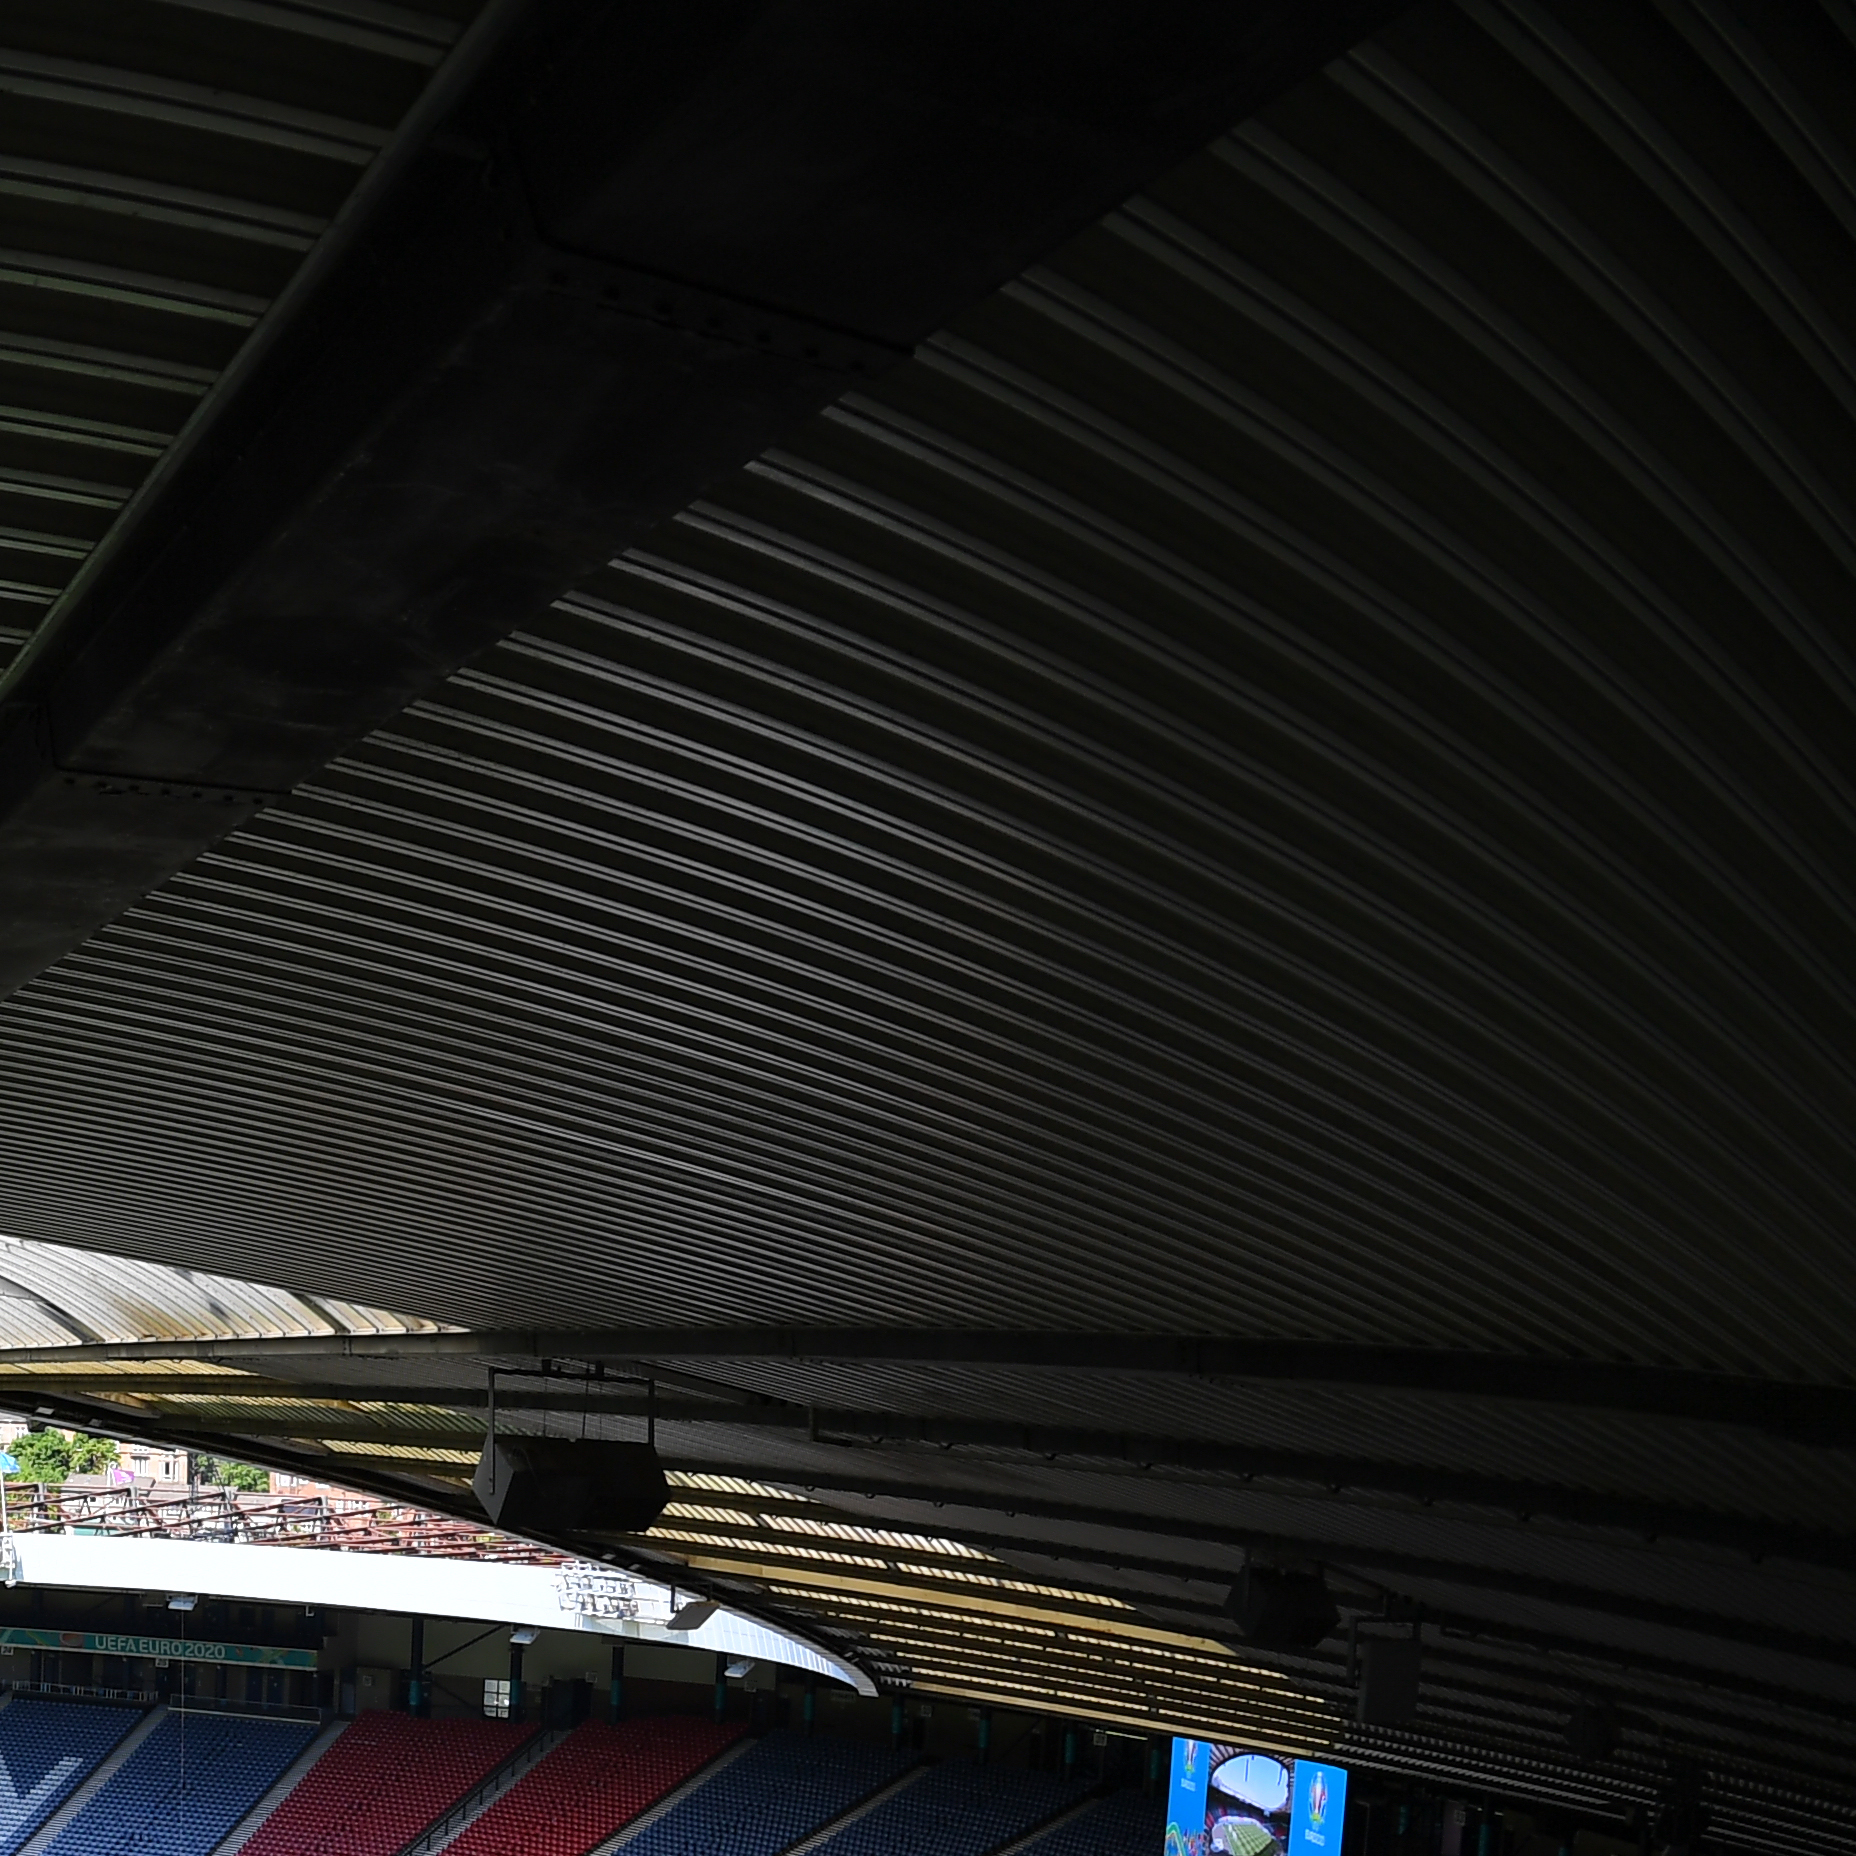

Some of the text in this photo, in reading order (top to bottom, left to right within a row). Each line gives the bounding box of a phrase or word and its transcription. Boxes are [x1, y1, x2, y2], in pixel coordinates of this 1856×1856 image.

[94, 1635, 226, 1659] UEFA EURO 2020
